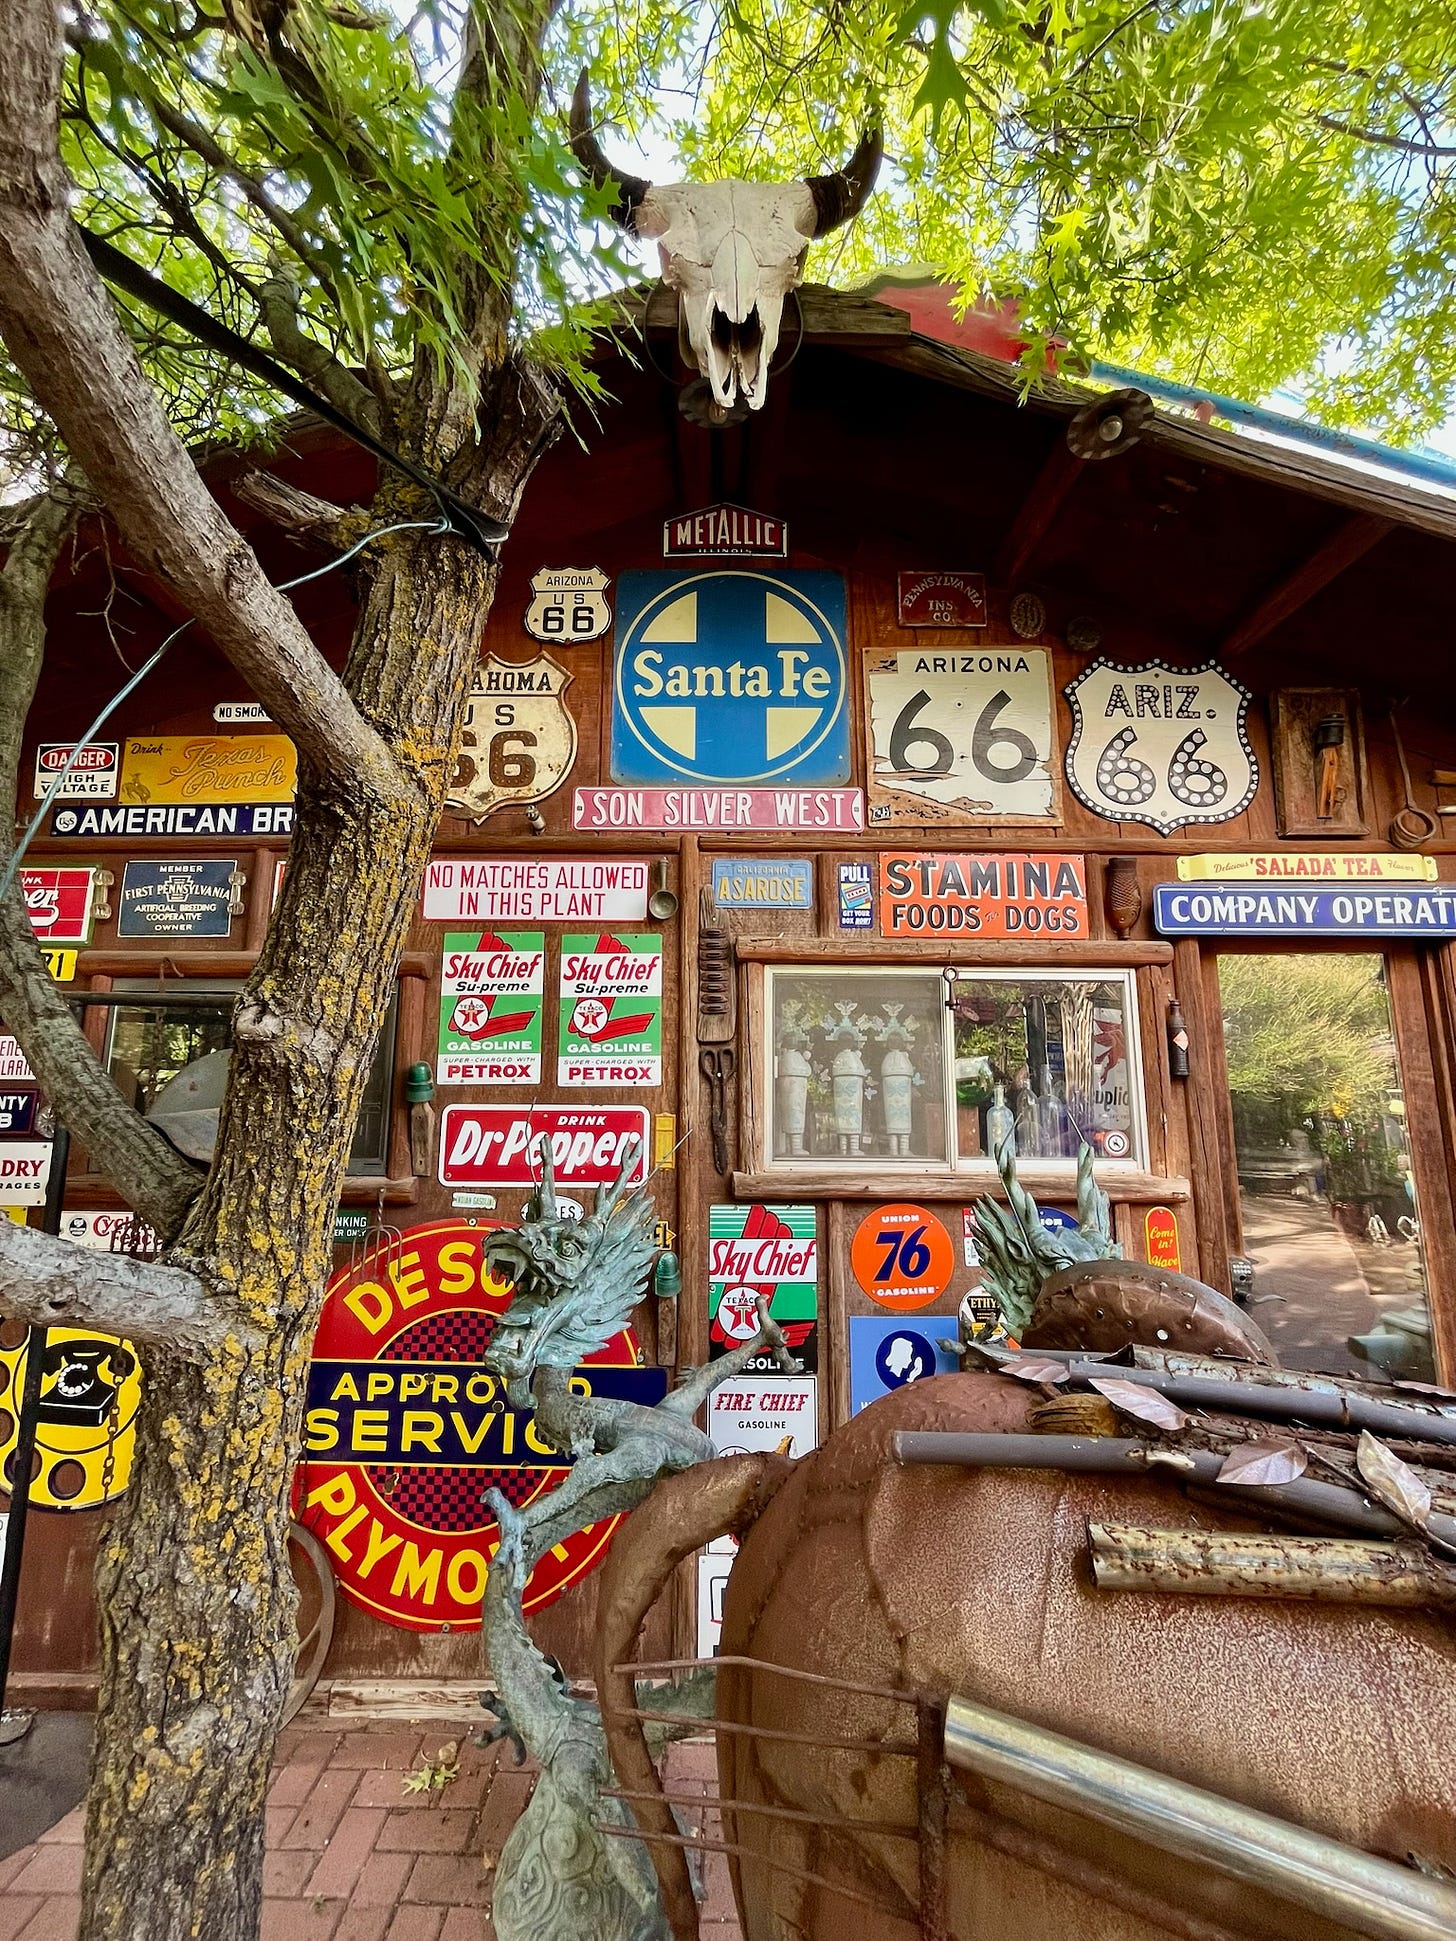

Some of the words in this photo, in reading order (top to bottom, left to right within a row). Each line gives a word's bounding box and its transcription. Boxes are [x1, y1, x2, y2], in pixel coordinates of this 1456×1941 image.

[677, 509, 775, 545] METALLIC
[546, 576, 594, 587] ARIZONA
[902, 575, 983, 609] PENNSYLVANIA
[542, 607, 595, 633] 66
[915, 657, 1030, 673] ARIZONA
[470, 672, 552, 691] AHOMA
[634, 650, 772, 698] Santa
[777, 650, 831, 699] Fe
[1104, 683, 1217, 720] ARIZ.
[219, 707, 232, 718] NO
[235, 707, 264, 718] SMOK
[888, 689, 1039, 784] 66
[130, 742, 164, 755] Drink
[170, 742, 271, 776] Texas
[1097, 726, 1230, 807] 66
[182, 757, 287, 798] Punch
[41, 784, 110, 793] VLTAGE
[592, 792, 643, 825] SON
[665, 792, 752, 825] SILVER
[774, 793, 845, 826] WEST
[79, 807, 237, 834] AMERICAN
[252, 806, 297, 833] BR
[159, 865, 204, 873] MEMBER
[736, 866, 790, 876] CALIFORNIA
[840, 866, 870, 882] PULL
[1213, 861, 1249, 874] Delicious
[1343, 858, 1383, 876] TEA
[429, 865, 453, 888] NO
[460, 865, 549, 889] MATCHES
[555, 866, 644, 889] ALLOWED
[886, 859, 1083, 900] STAMINA
[125, 885, 154, 900] FIRST
[157, 883, 230, 900] PENNSYLVANIA
[718, 876, 806, 902] ASAROSE
[134, 904, 176, 913] ARTIFICIAL
[180, 903, 217, 912] BREEDING
[459, 892, 479, 915] IN
[487, 892, 533, 916] THIS
[540, 893, 606, 916] PLANT
[1171, 895, 1319, 924] COMPANY
[146, 913, 202, 921] COOPERATIVE
[892, 903, 981, 931] FOODS
[1005, 905, 1079, 932] DOGS
[444, 954, 486, 982] Sky
[487, 953, 542, 978] Chief
[563, 956, 603, 984] Sky
[605, 955, 660, 980] Chief
[455, 981, 530, 993] Su-preme
[574, 983, 649, 995] Su-preme
[446, 1041, 532, 1051] GASOLINE
[567, 1043, 652, 1053] GASOLINE
[447, 1064, 531, 1078] PETROX
[568, 1067, 652, 1080] PETROX
[557, 1116, 607, 1126] DRINK
[335, 1216, 367, 1228] NKING
[881, 1214, 920, 1223] UNION
[1150, 1226, 1175, 1239] Come
[709, 1240, 753, 1283] Sky
[753, 1240, 817, 1276] Chief
[873, 1225, 931, 1281] 76
[1152, 1255, 1178, 1267] Have
[876, 1287, 936, 1296] GASOLINE
[330, 1372, 592, 1404] APPROD
[714, 1393, 756, 1411] FIRE
[760, 1393, 809, 1411] CHIEF
[305, 1408, 557, 1455] SERVIC
[738, 1421, 787, 1429] GASOLINE
[307, 1471, 560, 1605] PLYMO
